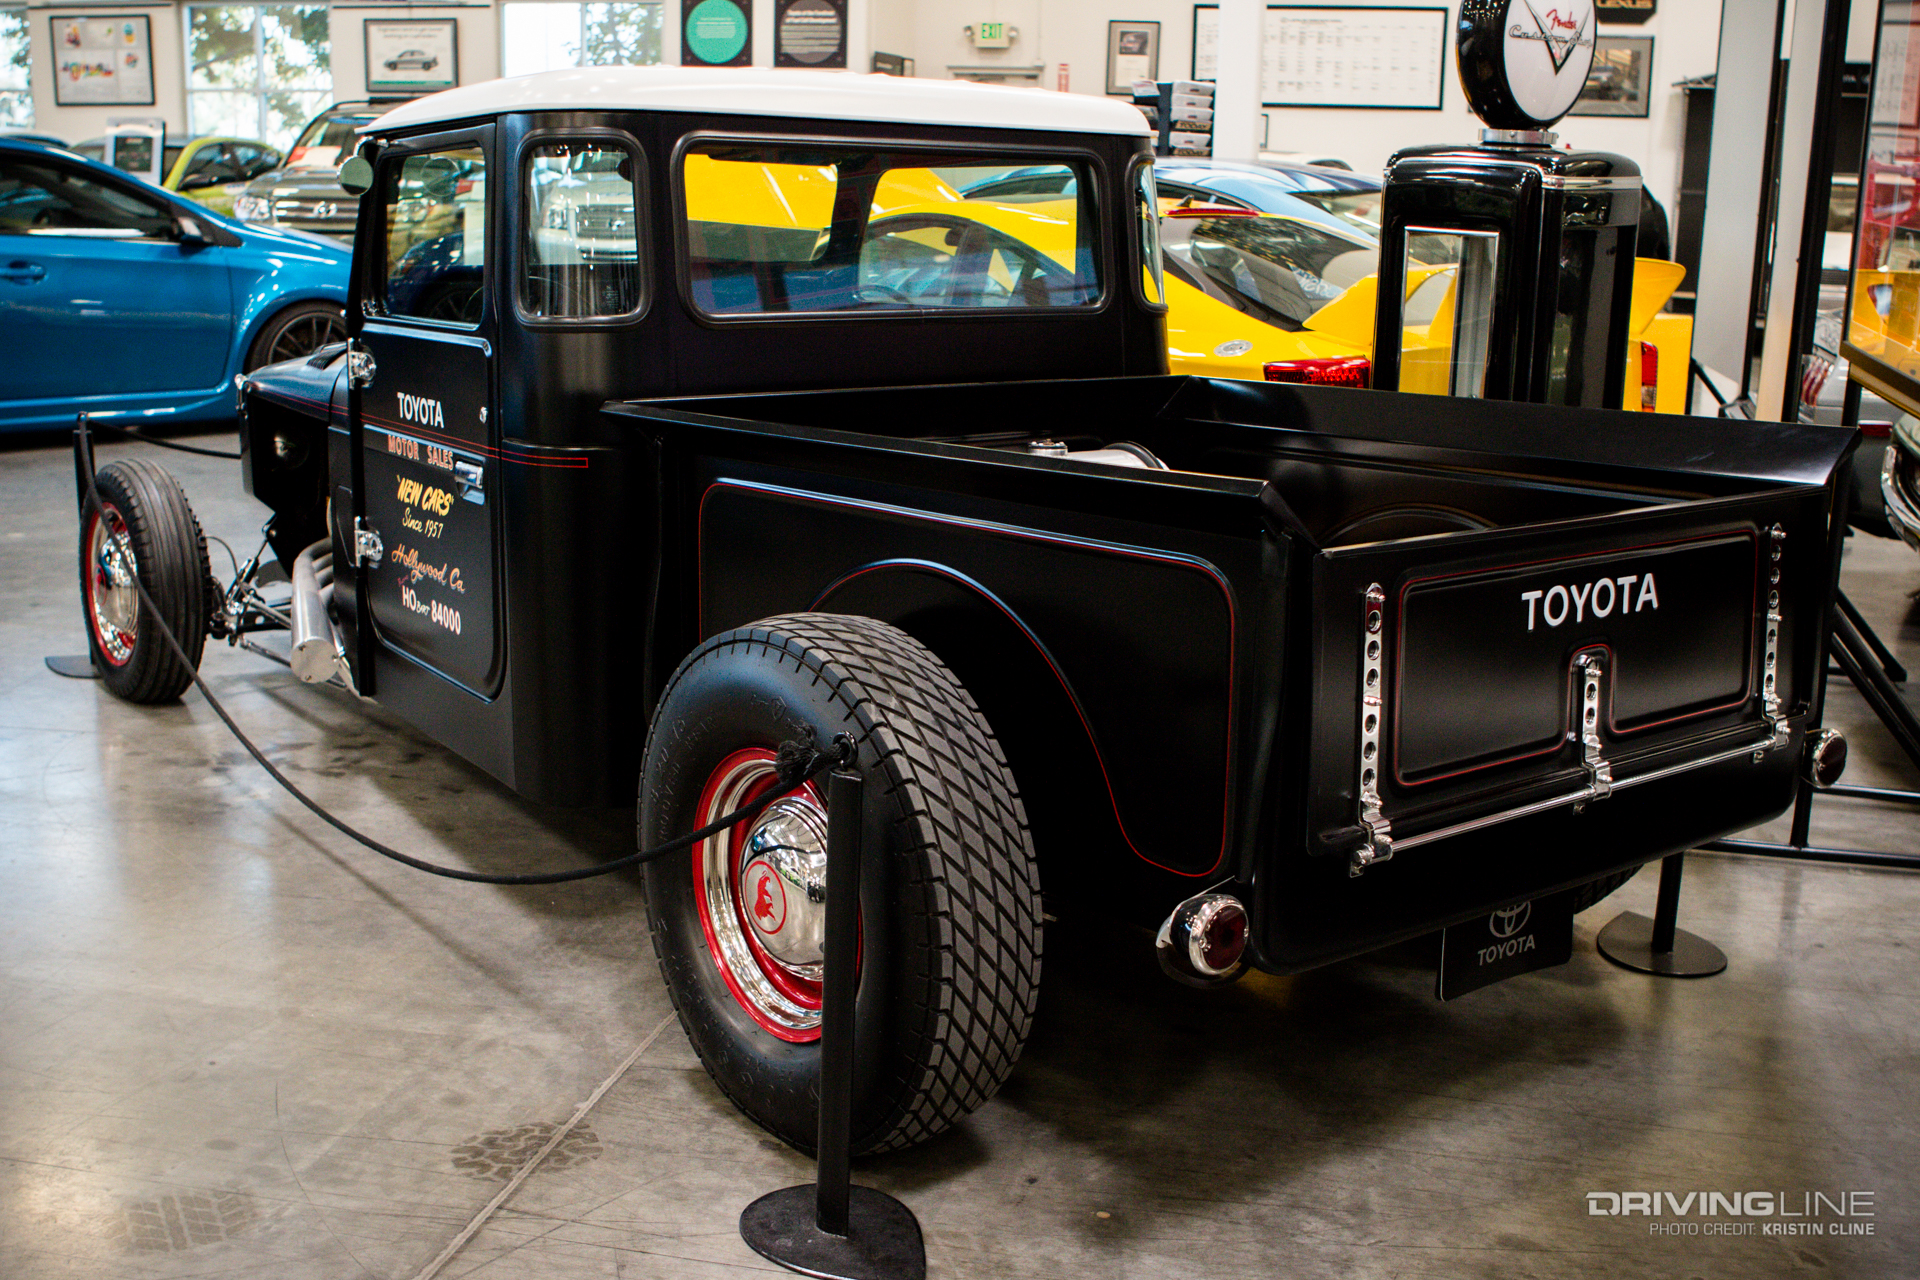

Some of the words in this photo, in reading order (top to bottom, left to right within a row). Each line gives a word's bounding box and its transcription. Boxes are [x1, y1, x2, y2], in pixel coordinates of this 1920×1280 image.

[981, 23, 1003, 39] EXIT
[1508, 24, 1569, 43] Custom
[1546, 8, 1577, 30] Fender
[397, 391, 444, 429] TOYOTA
[387, 434, 420, 460] MOTOR
[427, 445, 454, 471] SALES
[402, 506, 423, 533] Since
[424, 518, 444, 539] 1957
[391, 543, 448, 586] Hollywood
[431, 599, 462, 636] 84000
[1521, 572, 1659, 632] TOYOTA
[1477, 934, 1536, 966] TOYOTA
